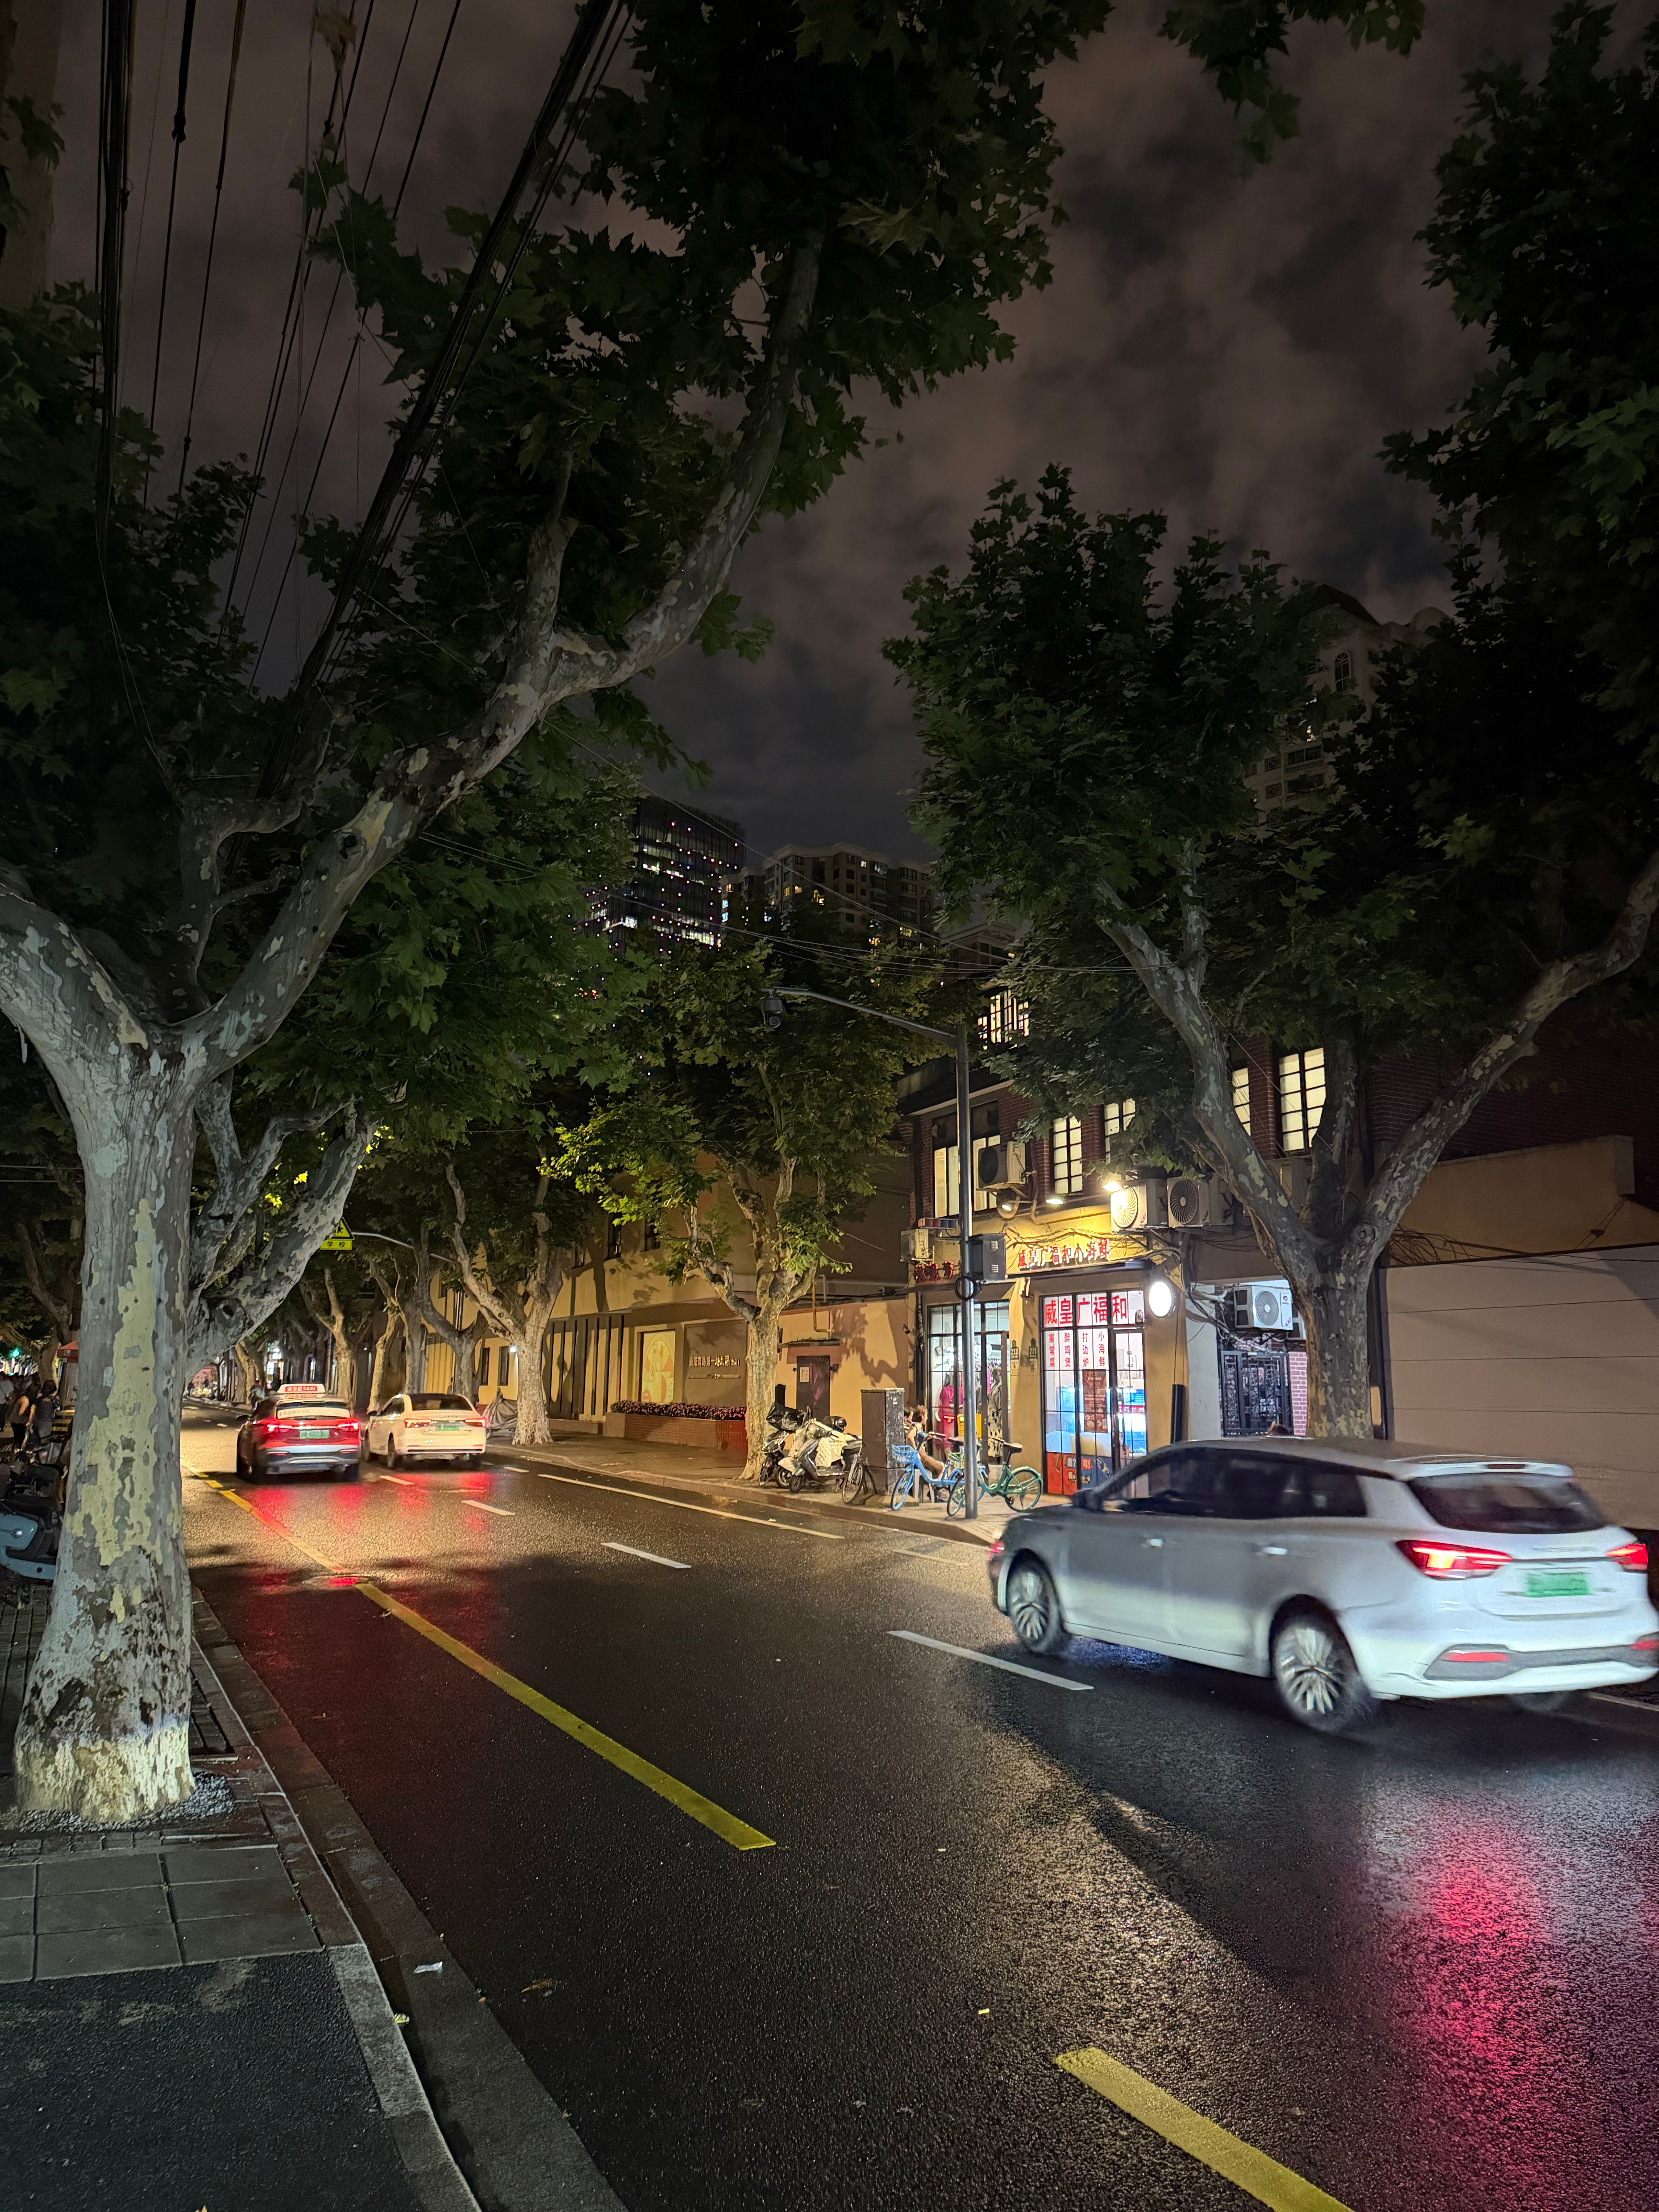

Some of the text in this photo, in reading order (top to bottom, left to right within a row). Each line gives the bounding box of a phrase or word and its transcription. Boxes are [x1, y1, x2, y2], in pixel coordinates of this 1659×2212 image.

[1044, 1295, 1127, 1325] 威皇广福和
